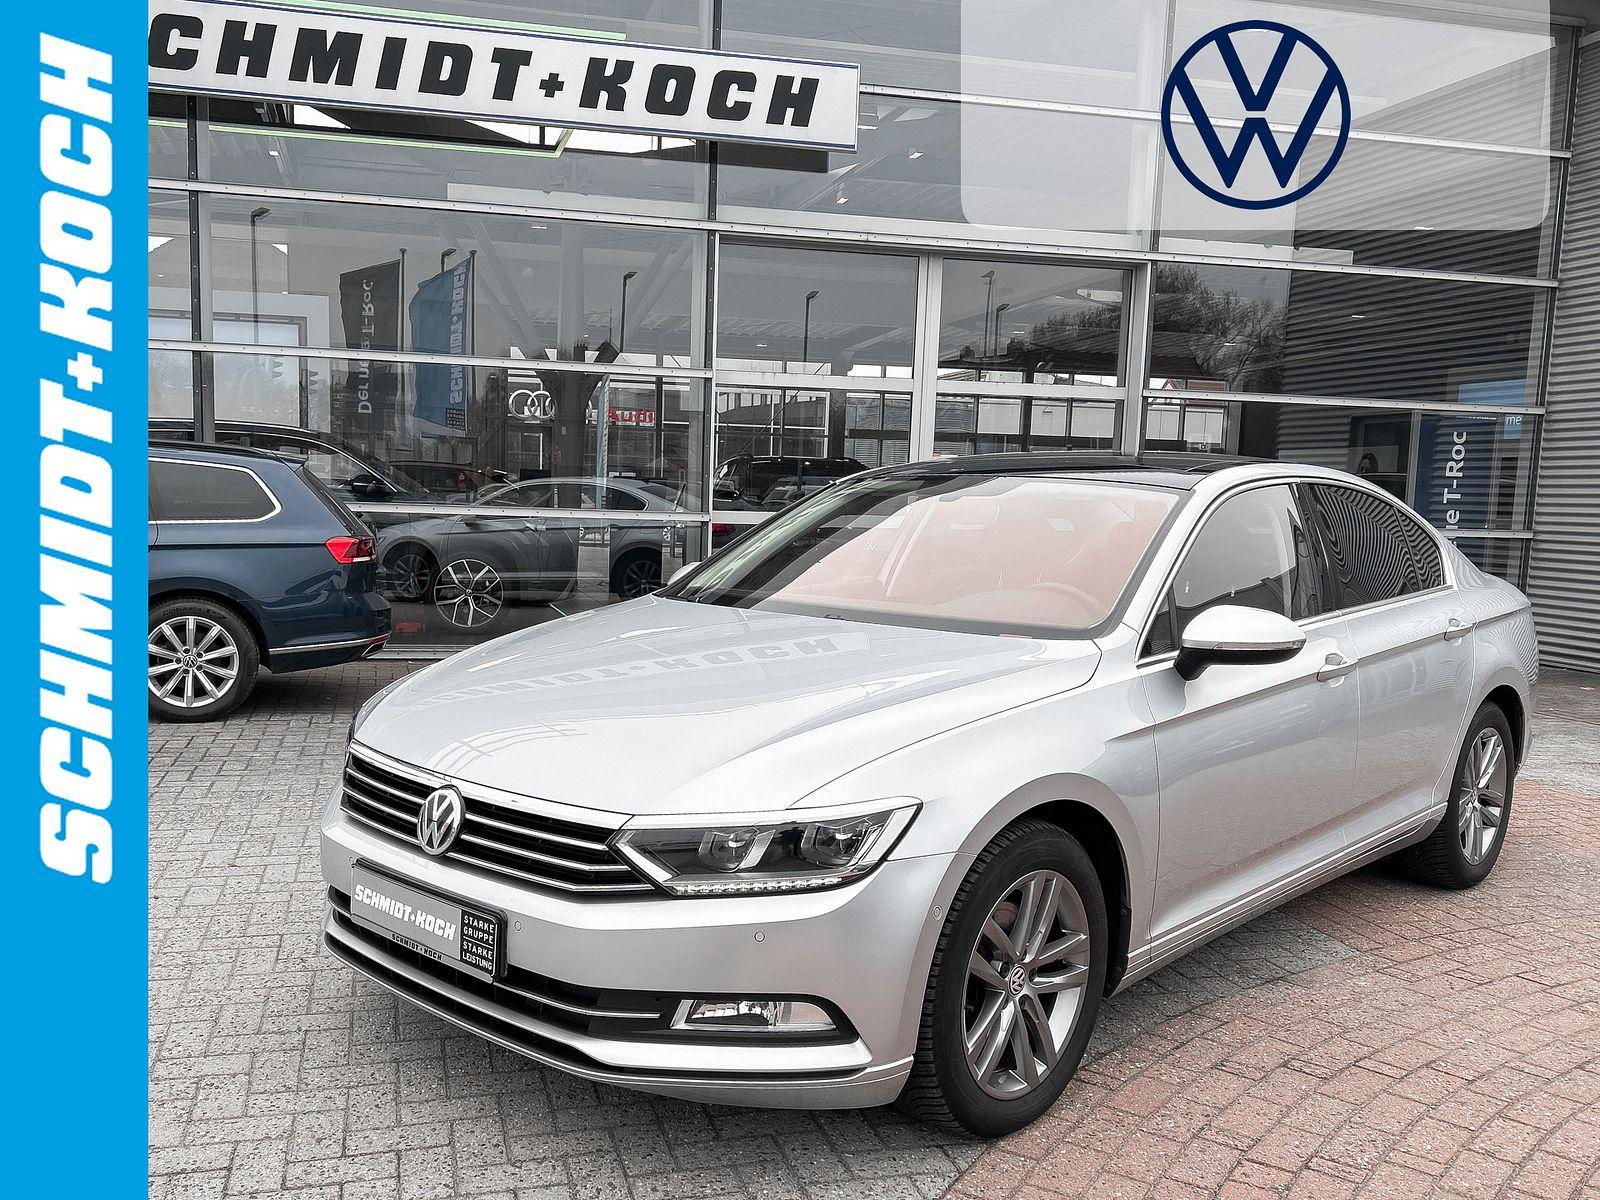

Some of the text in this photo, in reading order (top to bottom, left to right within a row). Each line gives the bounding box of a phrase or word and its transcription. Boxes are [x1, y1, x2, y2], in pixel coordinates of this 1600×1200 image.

[1443, 431, 1467, 504] T-Roc
[354, 884, 457, 941] SCHMIDT+KOCH
[463, 915, 495, 933] STARKE
[463, 926, 494, 944] GRUPPE
[463, 941, 493, 959] STARKE
[462, 952, 493, 970] LEISTUNG
